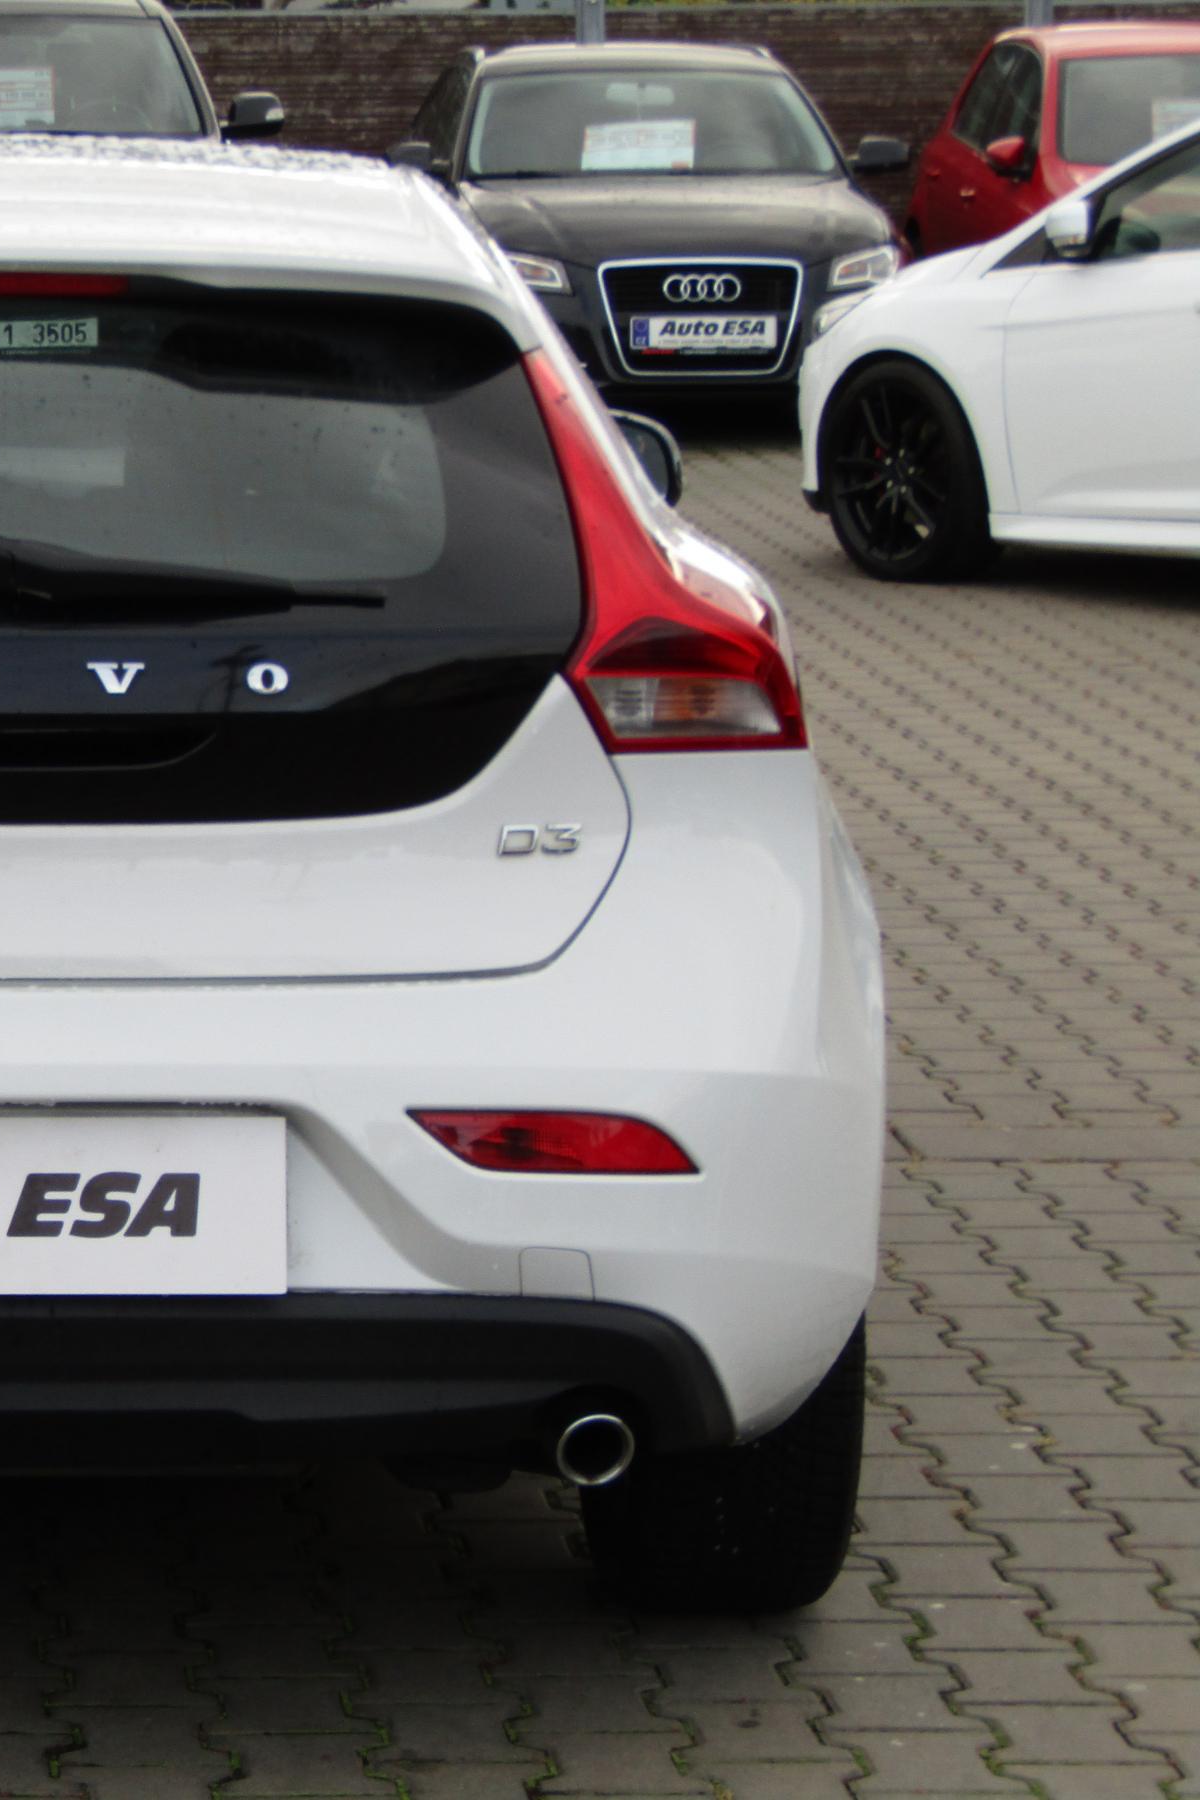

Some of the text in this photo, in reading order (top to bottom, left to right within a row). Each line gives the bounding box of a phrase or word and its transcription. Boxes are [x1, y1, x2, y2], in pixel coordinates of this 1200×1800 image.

[32, 322, 88, 345] 3505
[660, 320, 766, 337] Auto ESA
[497, 823, 581, 857] D3
[6, 1171, 201, 1239] ESA
